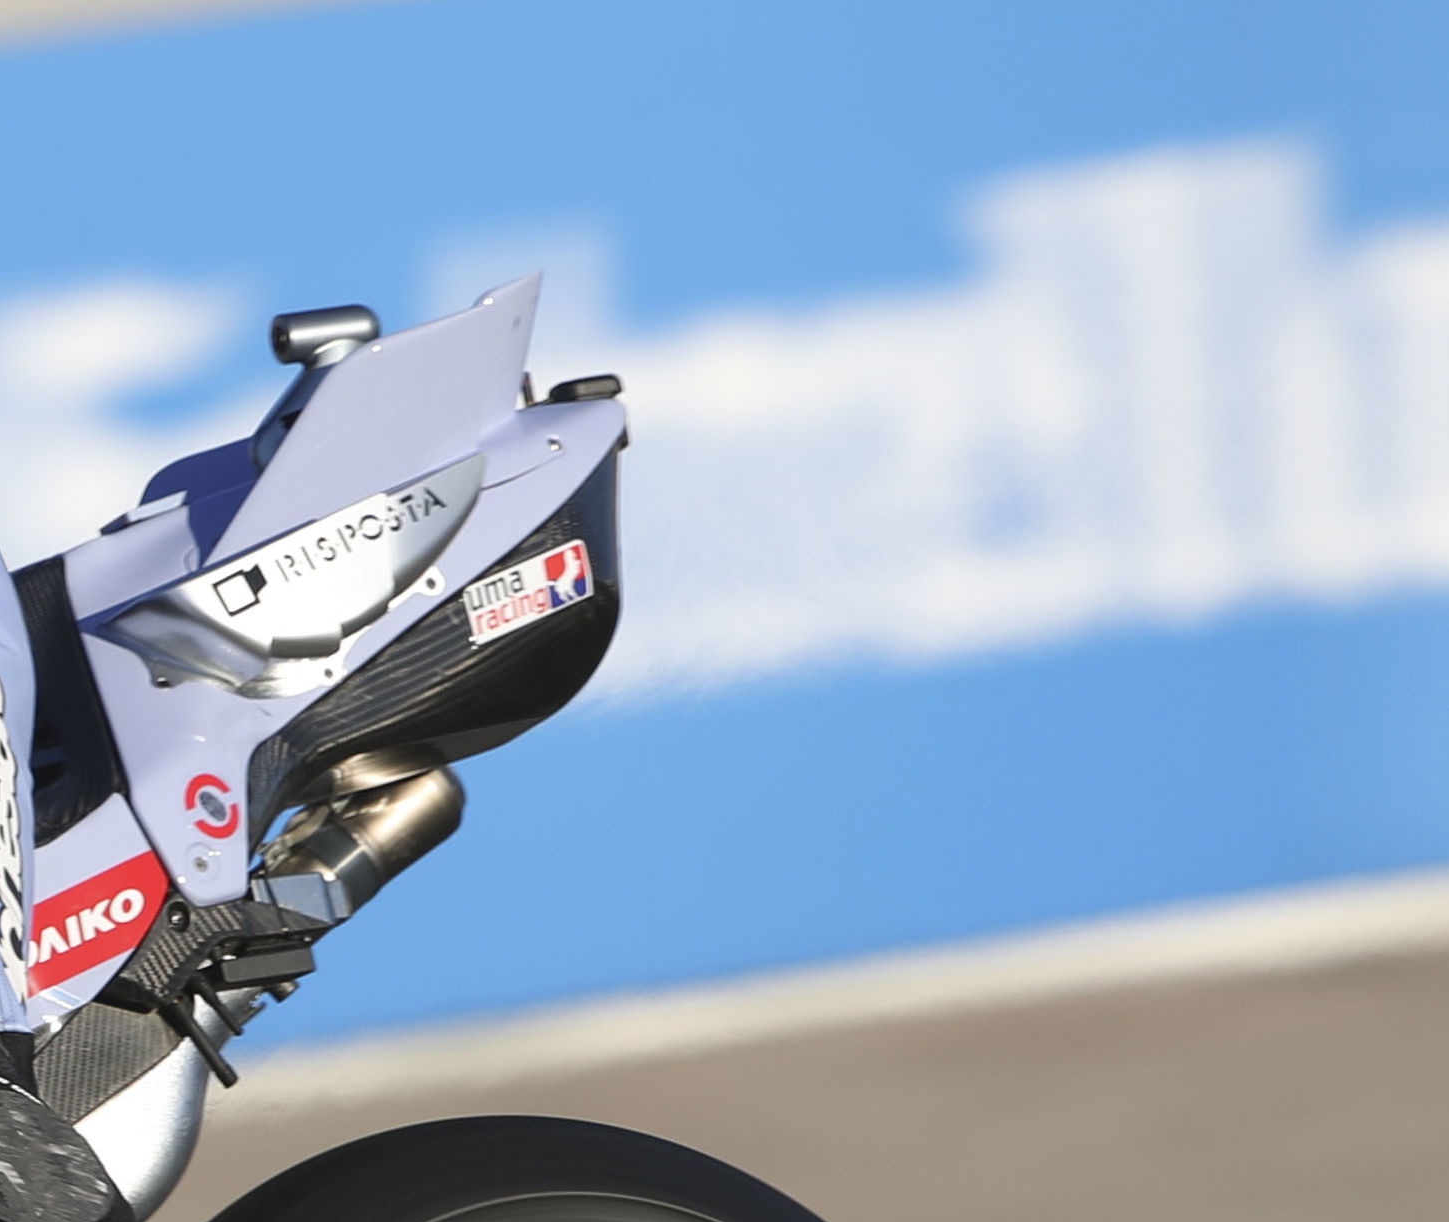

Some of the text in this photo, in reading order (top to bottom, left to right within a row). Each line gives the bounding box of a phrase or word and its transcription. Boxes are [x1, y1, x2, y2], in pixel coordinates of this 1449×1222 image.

[274, 487, 447, 584] RISPOSTA
[468, 567, 524, 612] uma
[475, 585, 550, 636] racing
